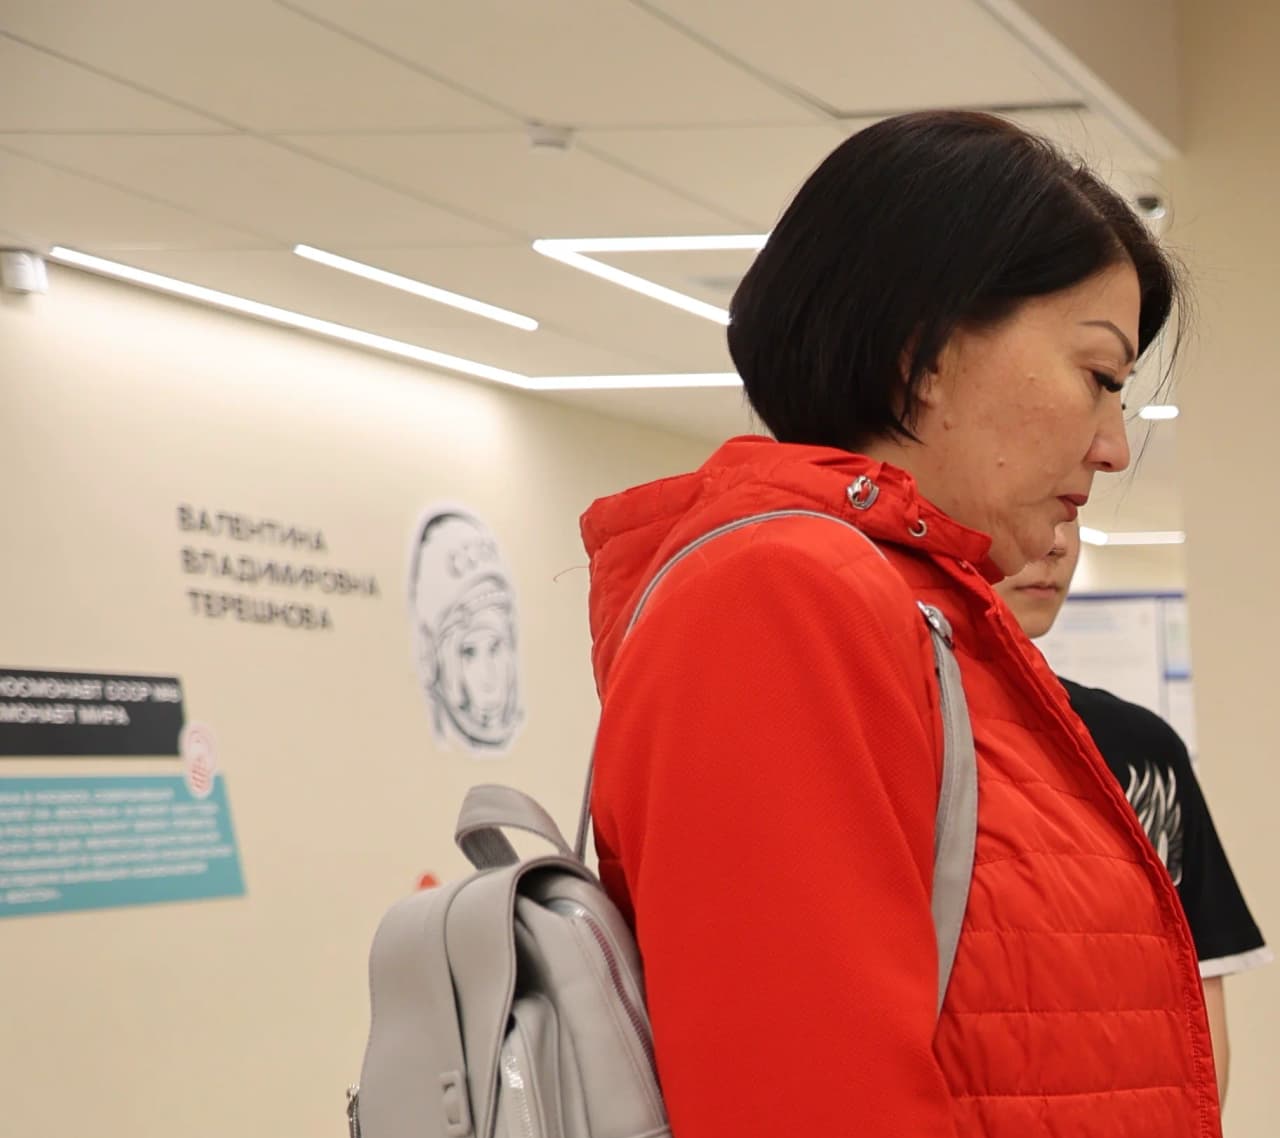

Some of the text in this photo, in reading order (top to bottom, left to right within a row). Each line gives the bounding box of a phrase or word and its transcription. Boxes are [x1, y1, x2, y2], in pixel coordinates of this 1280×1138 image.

[176, 504, 328, 552] ВАЛЕНТИНА
[181, 546, 380, 597] ВЛАДИМИРОВНА
[187, 588, 333, 631] ТЕРЕШКОВА
